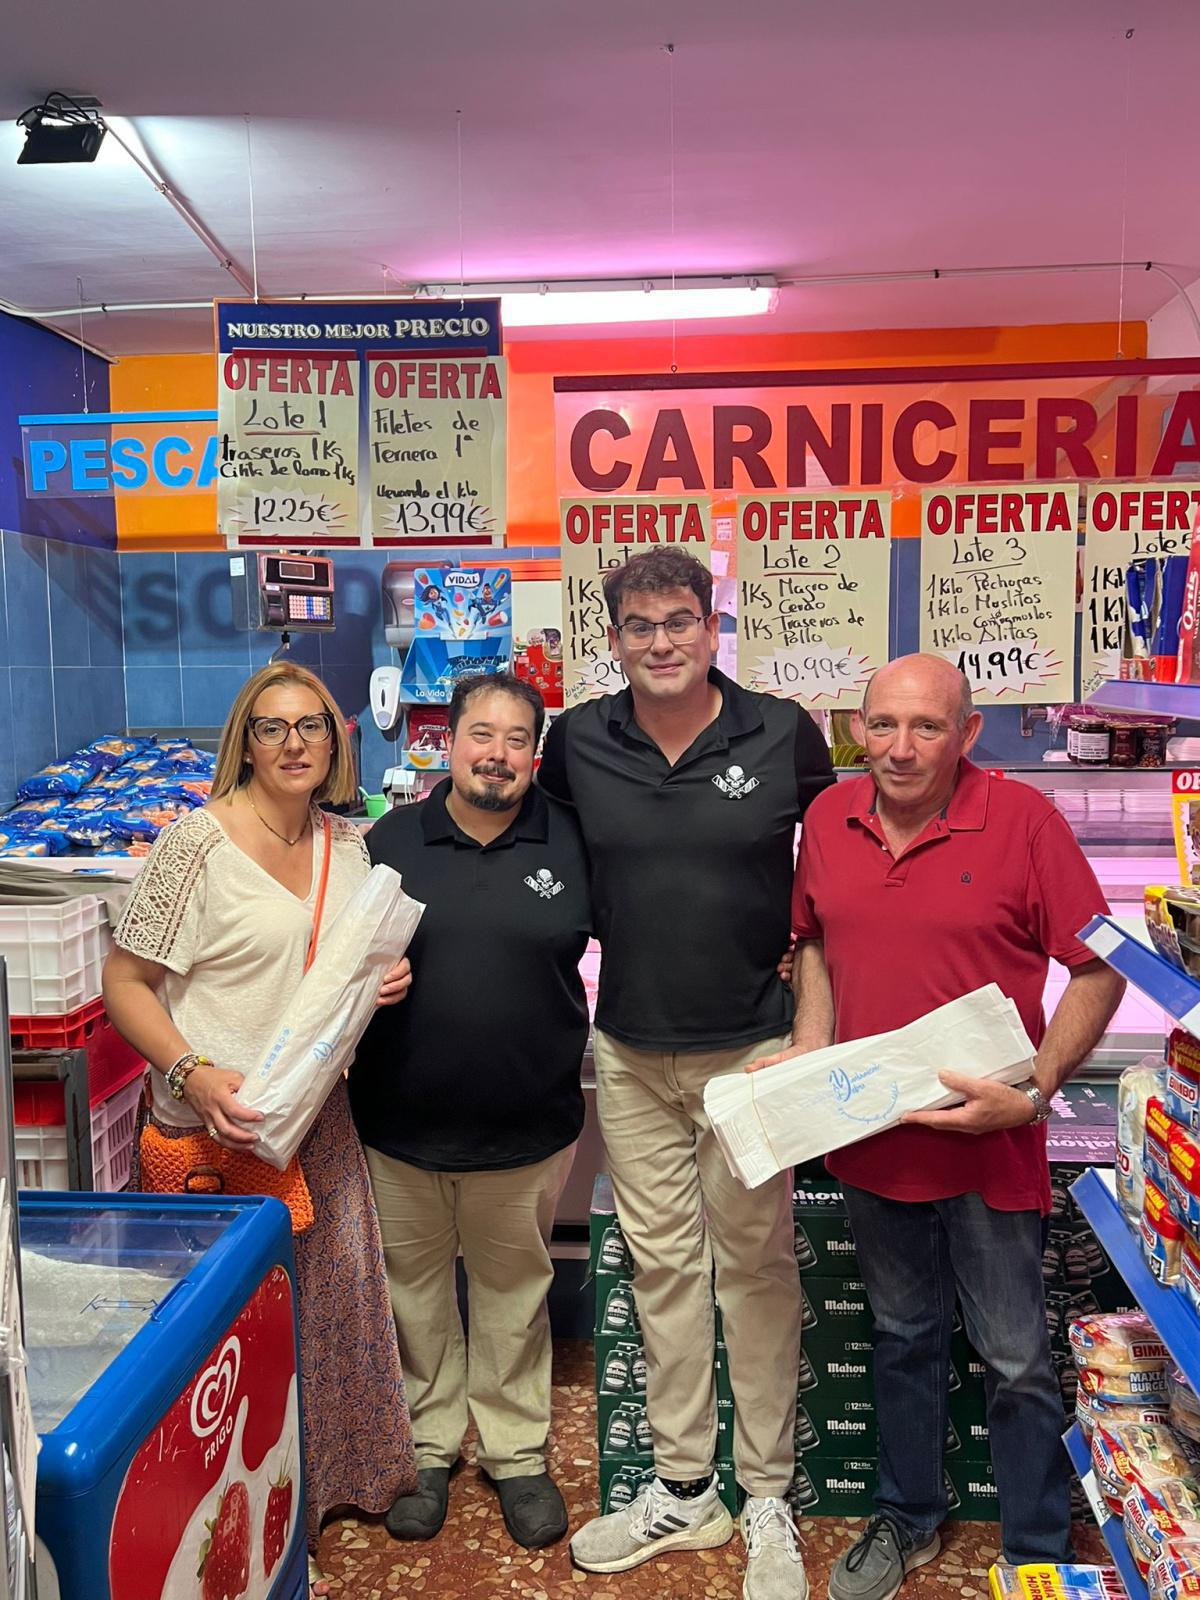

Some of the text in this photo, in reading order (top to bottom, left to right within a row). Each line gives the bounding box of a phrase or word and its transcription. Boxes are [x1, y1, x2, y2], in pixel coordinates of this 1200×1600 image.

[227, 317, 490, 338] NUESTRO MEJOR PRECIO
[223, 355, 354, 396] OFERTA
[374, 362, 502, 399] OFERTA
[243, 399, 304, 429] Lote
[373, 408, 480, 435] Filetes de
[570, 391, 1200, 492] CARNICERIA
[29, 436, 218, 491] PESCA
[270, 459, 290, 475] de
[743, 499, 885, 542] OFERTA
[927, 491, 1072, 535] OFERTA
[1092, 491, 1200, 532] OFER
[566, 503, 705, 544] OFERTA
[952, 536, 1027, 565] Lote 3
[1132, 531, 1177, 555] Lote
[598, 545, 632, 570] Lot
[763, 544, 841, 569] Lote 2
[449, 575, 478, 585] VIDAL
[837, 573, 859, 593] de
[1103, 567, 1125, 590] Kil
[848, 608, 865, 626] de
[1104, 596, 1124, 622] Kil
[778, 628, 823, 647] Pollo
[1102, 626, 1122, 650] Kil
[595, 661, 627, 686] 24
[415, 689, 424, 697] La
[1046, 1139, 1116, 1150] ahou
[793, 1190, 844, 1200] hou
[827, 1240, 856, 1250] Mah
[825, 1300, 864, 1311] Mahou
[1132, 1345, 1169, 1358] BIMB
[827, 1363, 866, 1373] Mahou
[1131, 1382, 1167, 1392] BURGE
[827, 1420, 866, 1430] Mahou
[1144, 1414, 1169, 1424] BIM
[205, 1416, 233, 1469] FRIGO
[826, 1479, 865, 1490] Mahou
[968, 1482, 998, 1493] Mah
